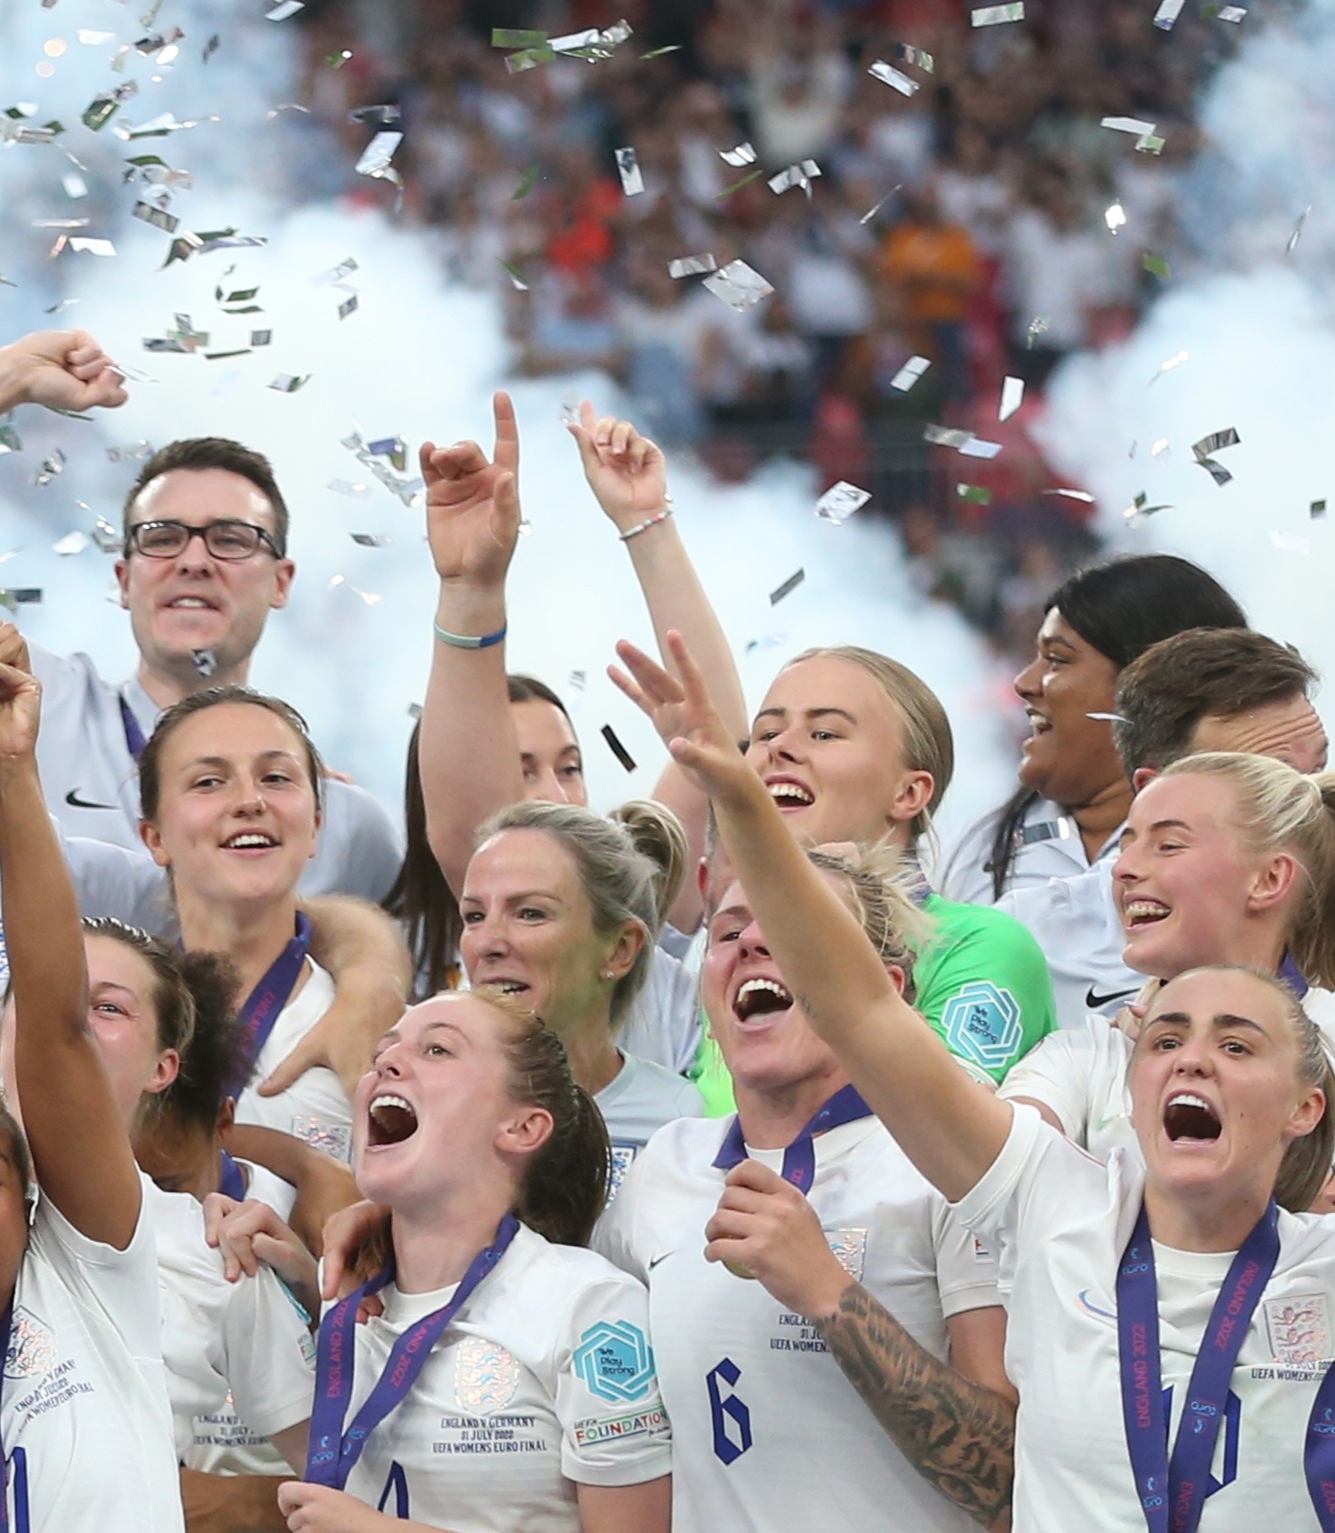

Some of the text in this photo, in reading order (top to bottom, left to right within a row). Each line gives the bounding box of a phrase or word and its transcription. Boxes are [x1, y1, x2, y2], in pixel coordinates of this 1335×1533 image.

[770, 1338, 831, 1353] UEFA WOMEN
[327, 1331, 344, 1398] ENGLAND
[392, 1355, 412, 1388] 2022
[602, 1366, 636, 1377] Strong
[1132, 1324, 1151, 1429] ENGLAND 2022
[1251, 1368, 1275, 1380] UEFA
[706, 1356, 754, 1466] 6
[441, 1415, 536, 1429] ENGLAND V GERMANY
[470, 1430, 493, 1441] JULY
[433, 1439, 548, 1454] UEFA WOMENS EURO FINAL
